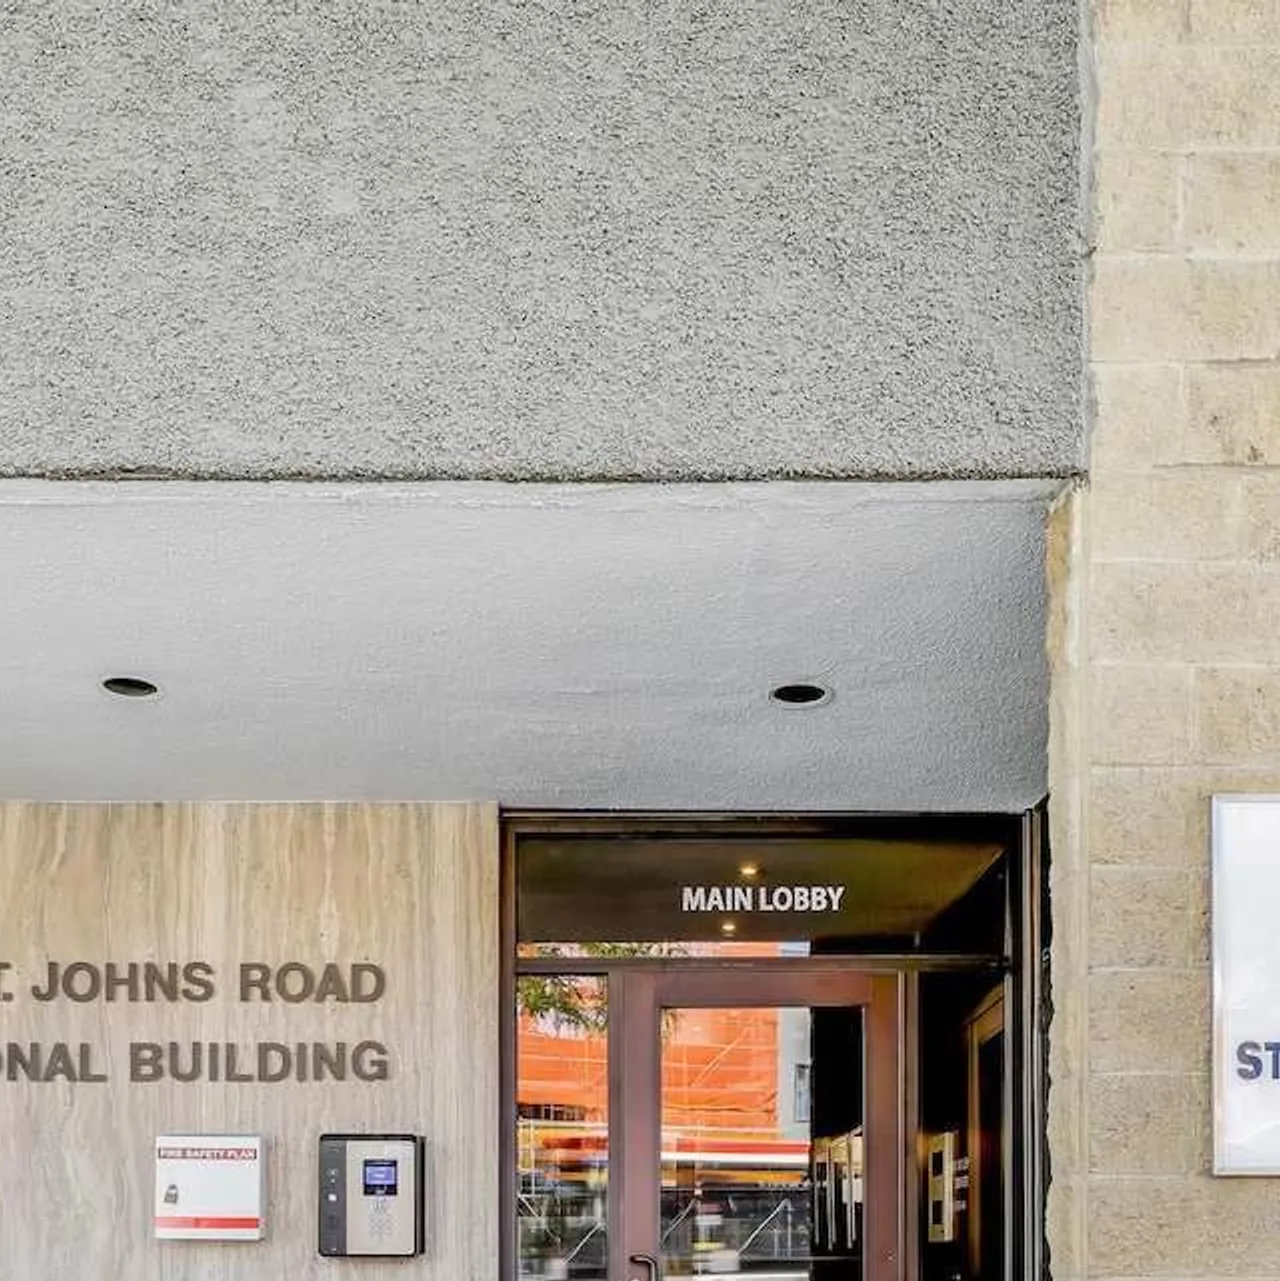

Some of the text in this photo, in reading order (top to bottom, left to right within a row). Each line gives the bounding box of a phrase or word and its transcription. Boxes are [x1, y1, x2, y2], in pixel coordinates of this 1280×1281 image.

[682, 886, 845, 911] MAIN LOBBY
[31, 961, 216, 1003] JOHNS
[239, 961, 387, 1003] ROAD
[129, 1040, 390, 1083] BUILDING
[186, 1149, 226, 1160] SAFETY
[228, 1149, 257, 1160] PLAN
